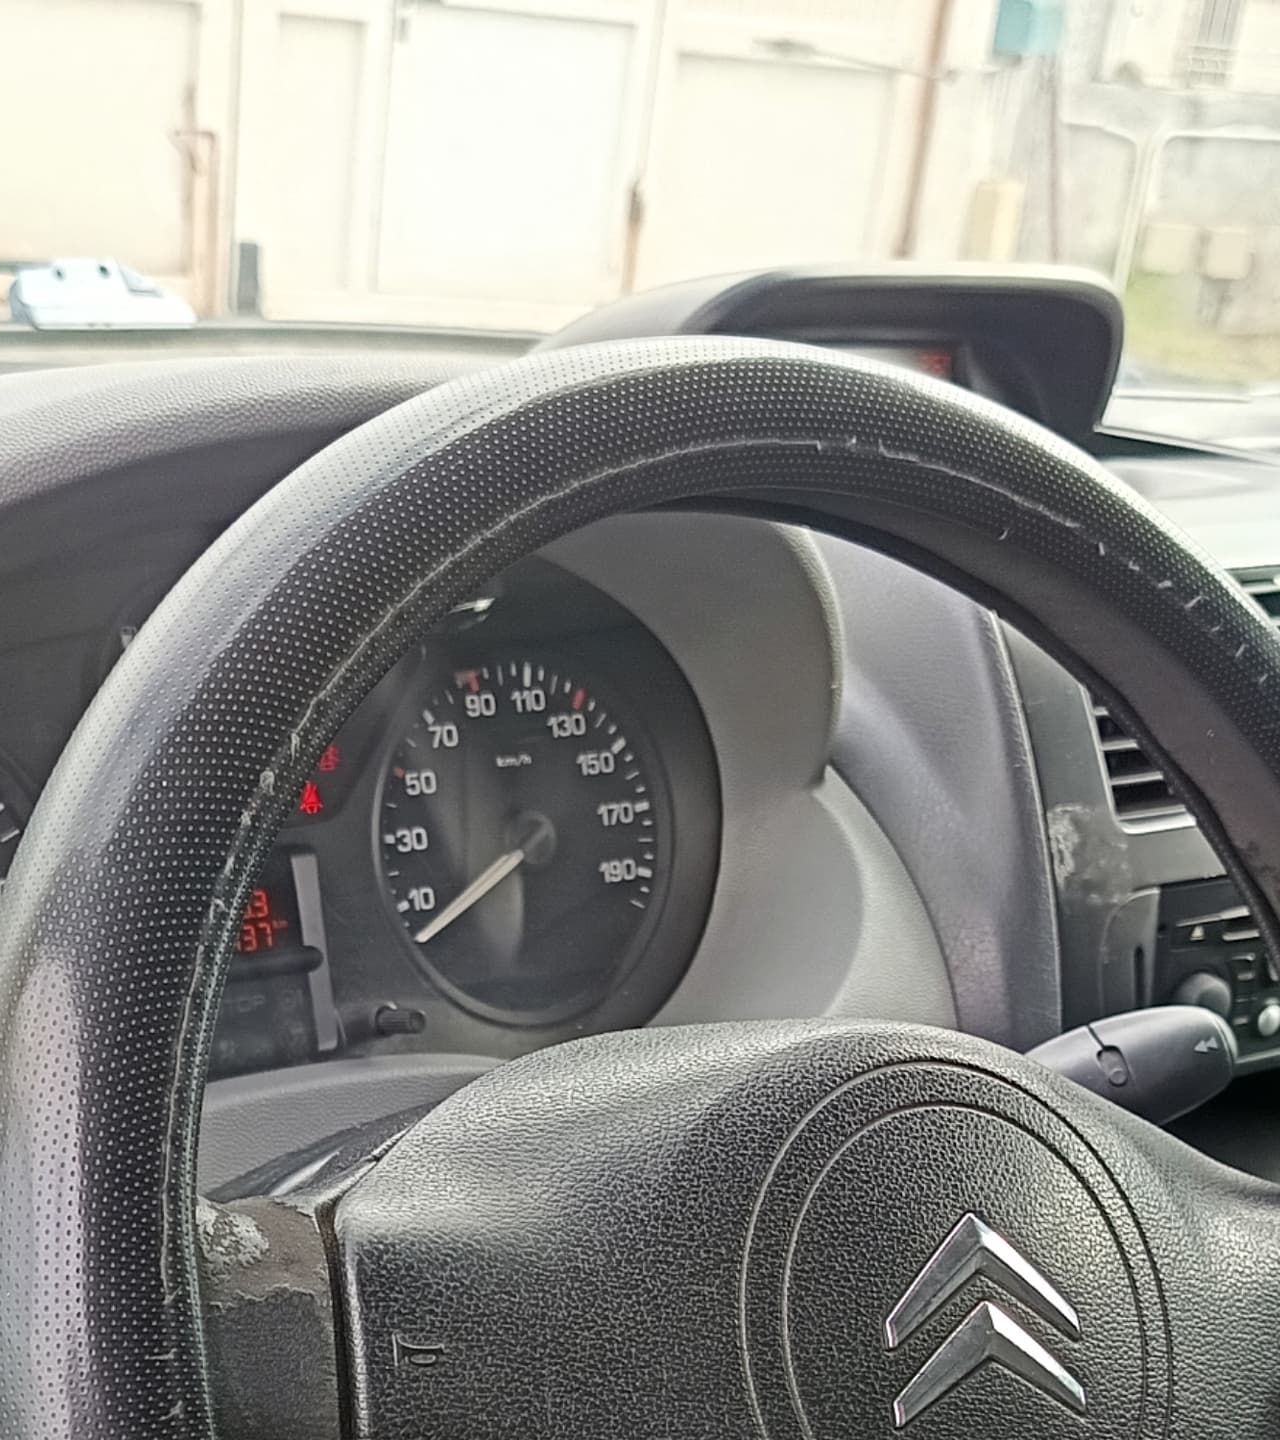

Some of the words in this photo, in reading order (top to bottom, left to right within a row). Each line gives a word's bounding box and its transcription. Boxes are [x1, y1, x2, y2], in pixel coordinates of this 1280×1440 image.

[465, 693, 496, 717] 90
[511, 689, 546, 713] 110
[428, 724, 459, 748] 70
[547, 714, 586, 738] 130
[576, 752, 615, 776] 150
[404, 771, 437, 795] 50
[598, 801, 634, 825] 170
[396, 827, 428, 850] 30
[599, 859, 636, 884] 190
[408, 887, 435, 910] 10
